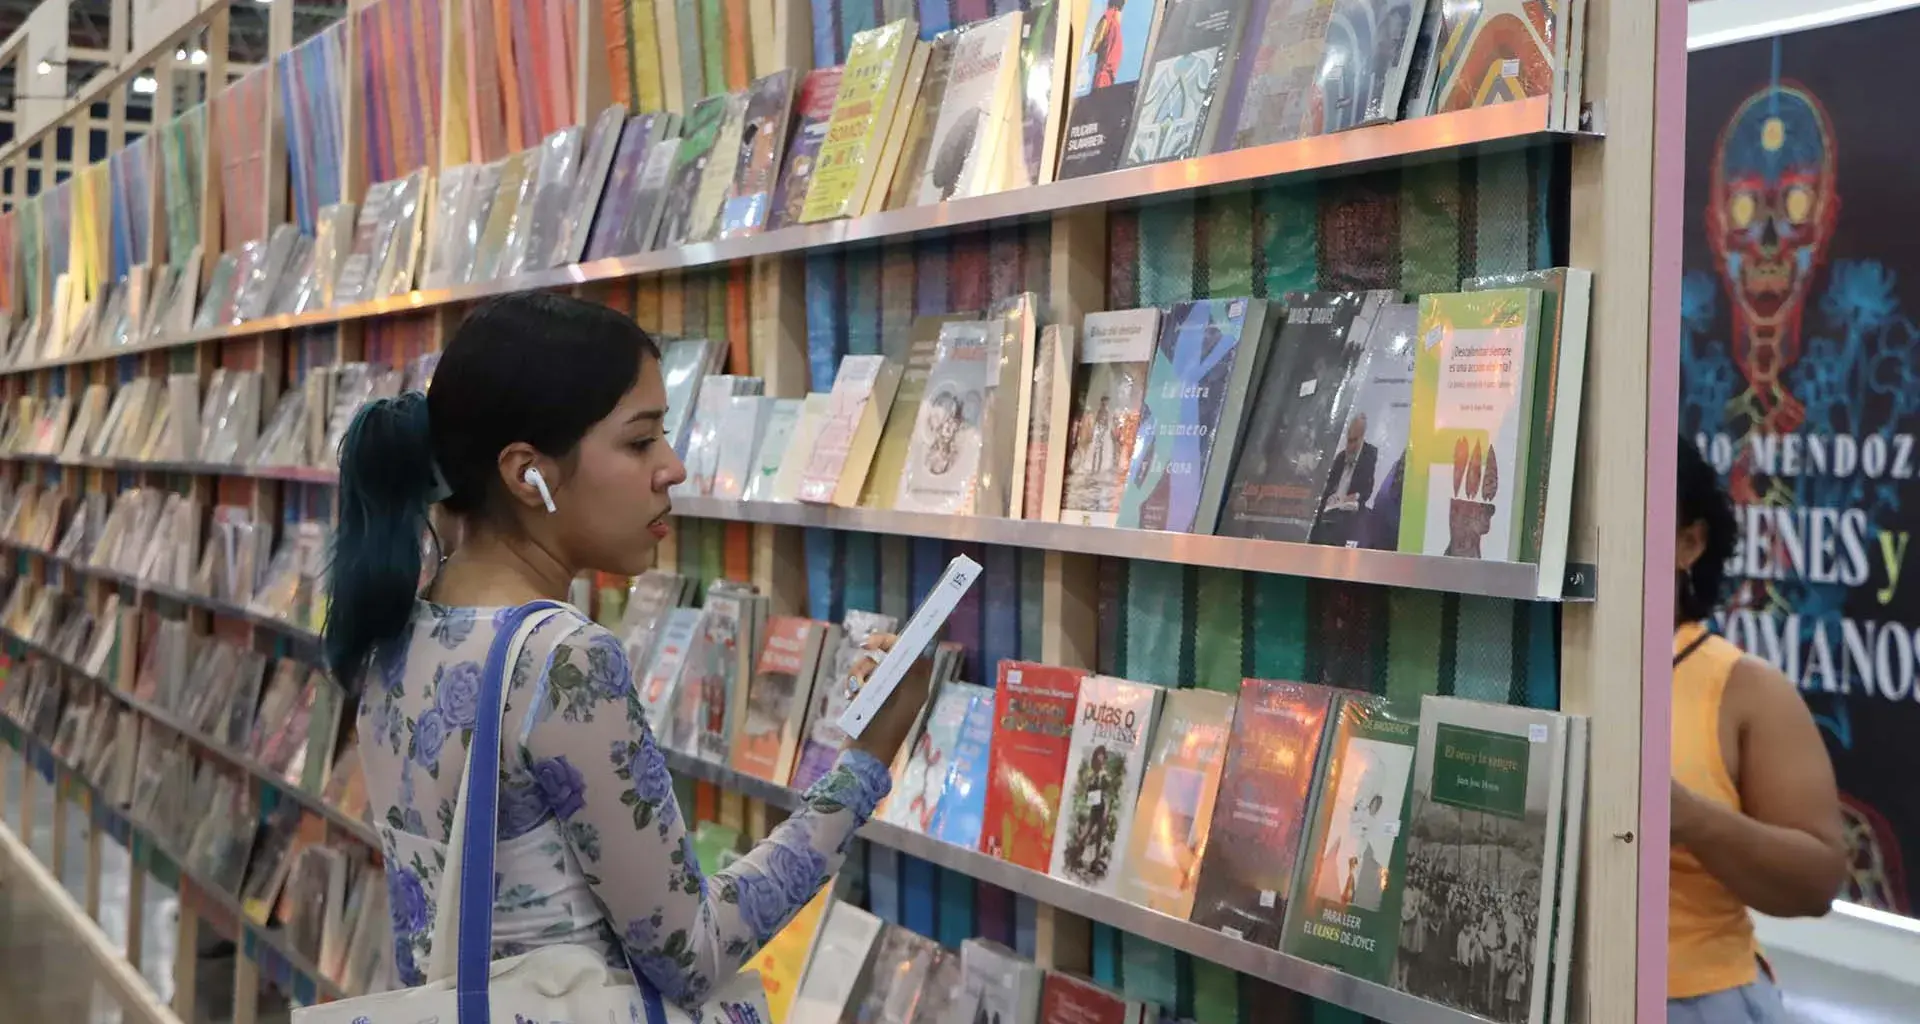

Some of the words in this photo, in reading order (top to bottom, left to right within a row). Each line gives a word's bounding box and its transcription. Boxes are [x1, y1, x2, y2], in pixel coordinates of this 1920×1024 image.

[1750, 432, 1920, 479] MENDOZ
[1876, 530, 1910, 605] y
[1082, 700, 1123, 726] putas
[1125, 709, 1136, 729] o
[1322, 907, 1341, 925] PARA
[1342, 913, 1362, 930] LEER
